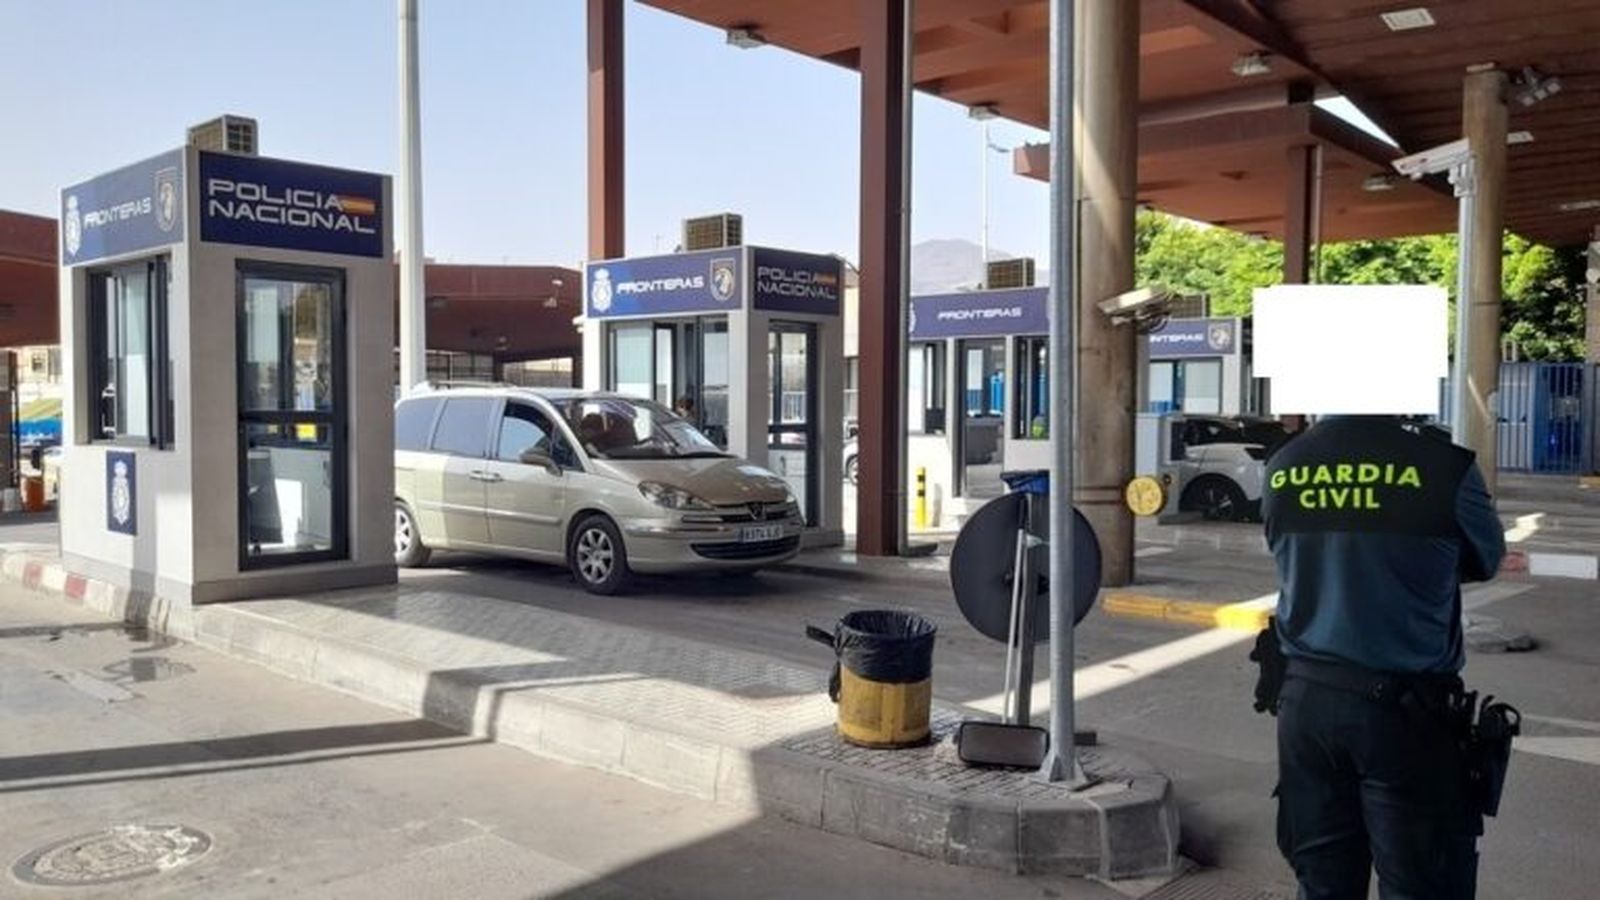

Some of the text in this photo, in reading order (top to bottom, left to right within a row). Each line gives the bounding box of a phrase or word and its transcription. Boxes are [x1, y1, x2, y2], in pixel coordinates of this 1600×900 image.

[208, 178, 343, 211] POLICIA
[83, 197, 152, 229] FRONTERAS
[208, 199, 376, 234] NACIONAL
[616, 276, 704, 294] FRONTERAS
[757, 266, 820, 284] POLICIA
[757, 280, 837, 300] NACIONAL
[938, 307, 1022, 321] FRONTERAS
[1270, 463, 1422, 489] GUARDIA
[1299, 488, 1380, 509] CIVIL
